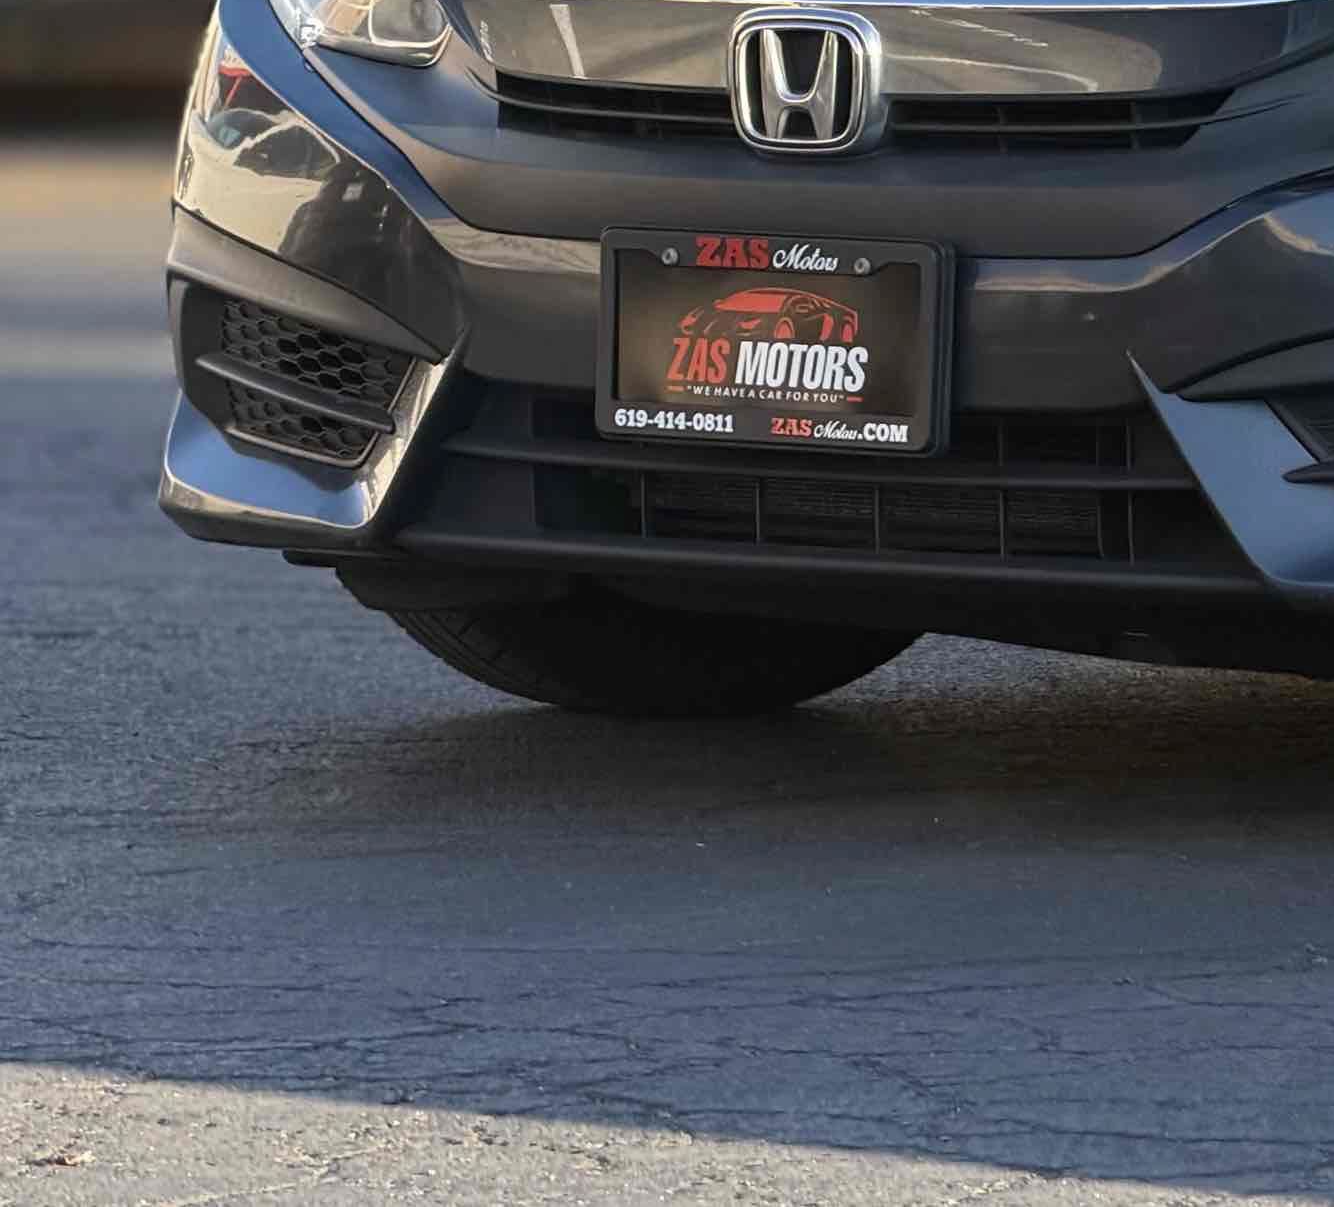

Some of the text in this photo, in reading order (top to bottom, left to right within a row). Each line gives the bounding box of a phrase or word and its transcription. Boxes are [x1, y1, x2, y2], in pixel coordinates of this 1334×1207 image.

[696, 236, 839, 271] ZAS Motors
[667, 337, 868, 392] ZAS MOTORS
[714, 386, 745, 398] HAVE
[747, 388, 755, 398] A
[786, 391, 809, 402] FOR
[614, 408, 734, 432] 619-414-0811
